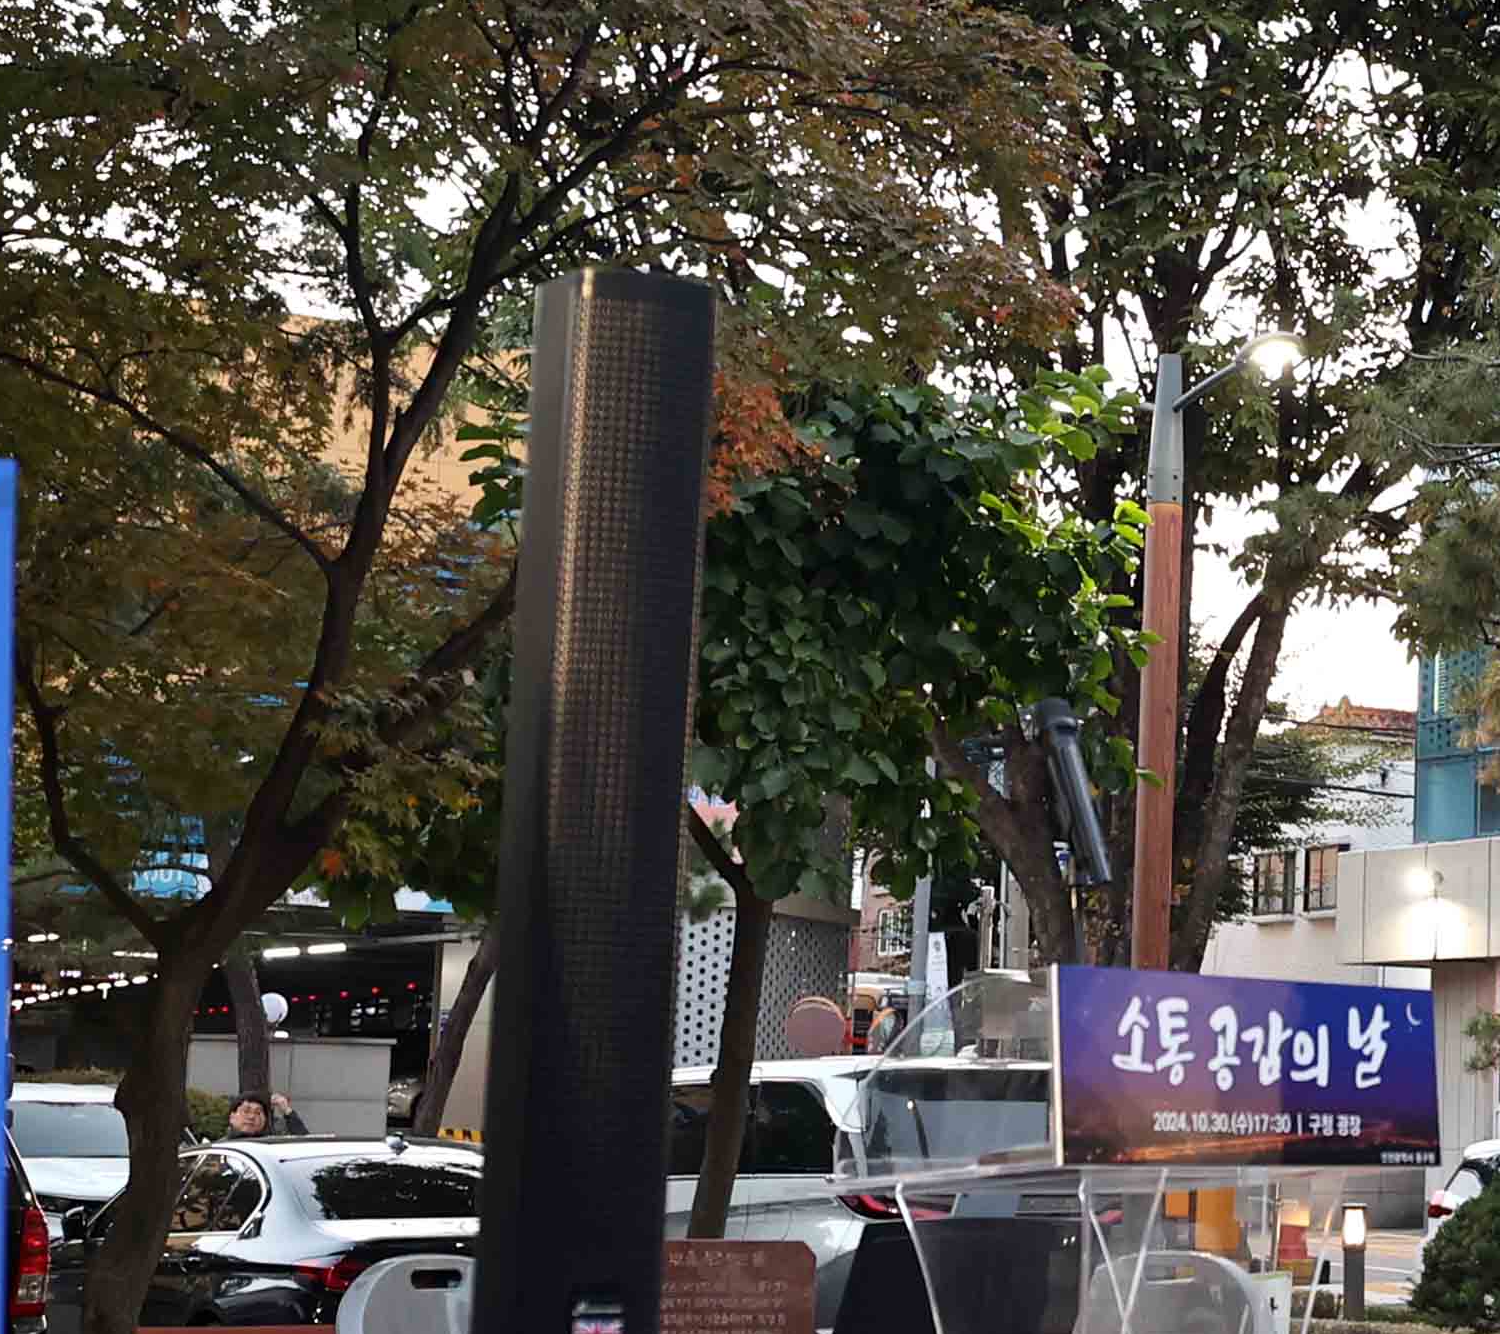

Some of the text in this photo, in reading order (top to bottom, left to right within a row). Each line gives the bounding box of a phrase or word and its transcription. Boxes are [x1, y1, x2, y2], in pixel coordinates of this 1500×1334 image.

[1111, 995, 1391, 1092] 소통 공감의 날
[1308, 1114, 1333, 1137] 구청
[1336, 1113, 1362, 1137] 광장
